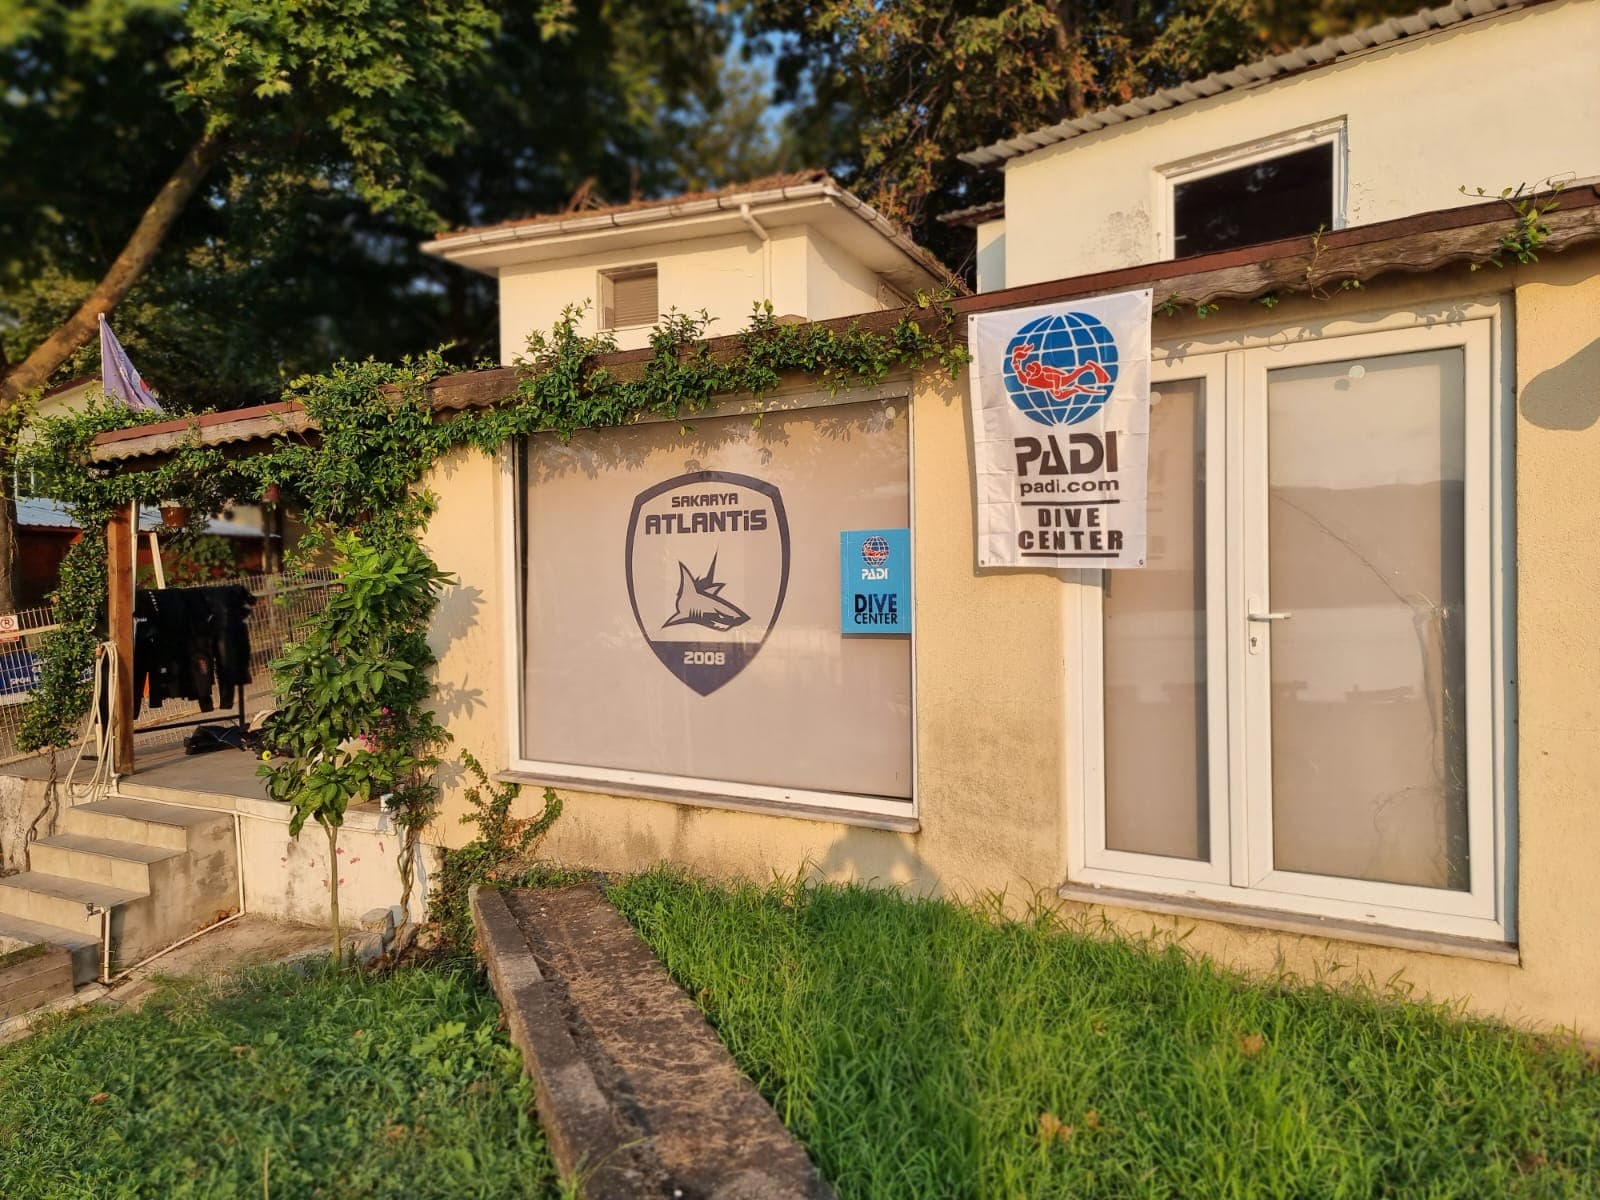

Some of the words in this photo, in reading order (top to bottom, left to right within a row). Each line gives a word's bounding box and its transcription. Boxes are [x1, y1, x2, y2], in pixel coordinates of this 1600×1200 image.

[1014, 430, 1119, 477] PADI
[1020, 478, 1120, 497] padi.com
[671, 493, 739, 508] SAKARYA
[1038, 507, 1100, 528] DIVE
[1018, 529, 1124, 551] CENTER
[861, 568, 889, 580] PADI
[854, 593, 898, 613] DIVE
[854, 612, 898, 625] CENTER
[683, 651, 726, 666] 2008
